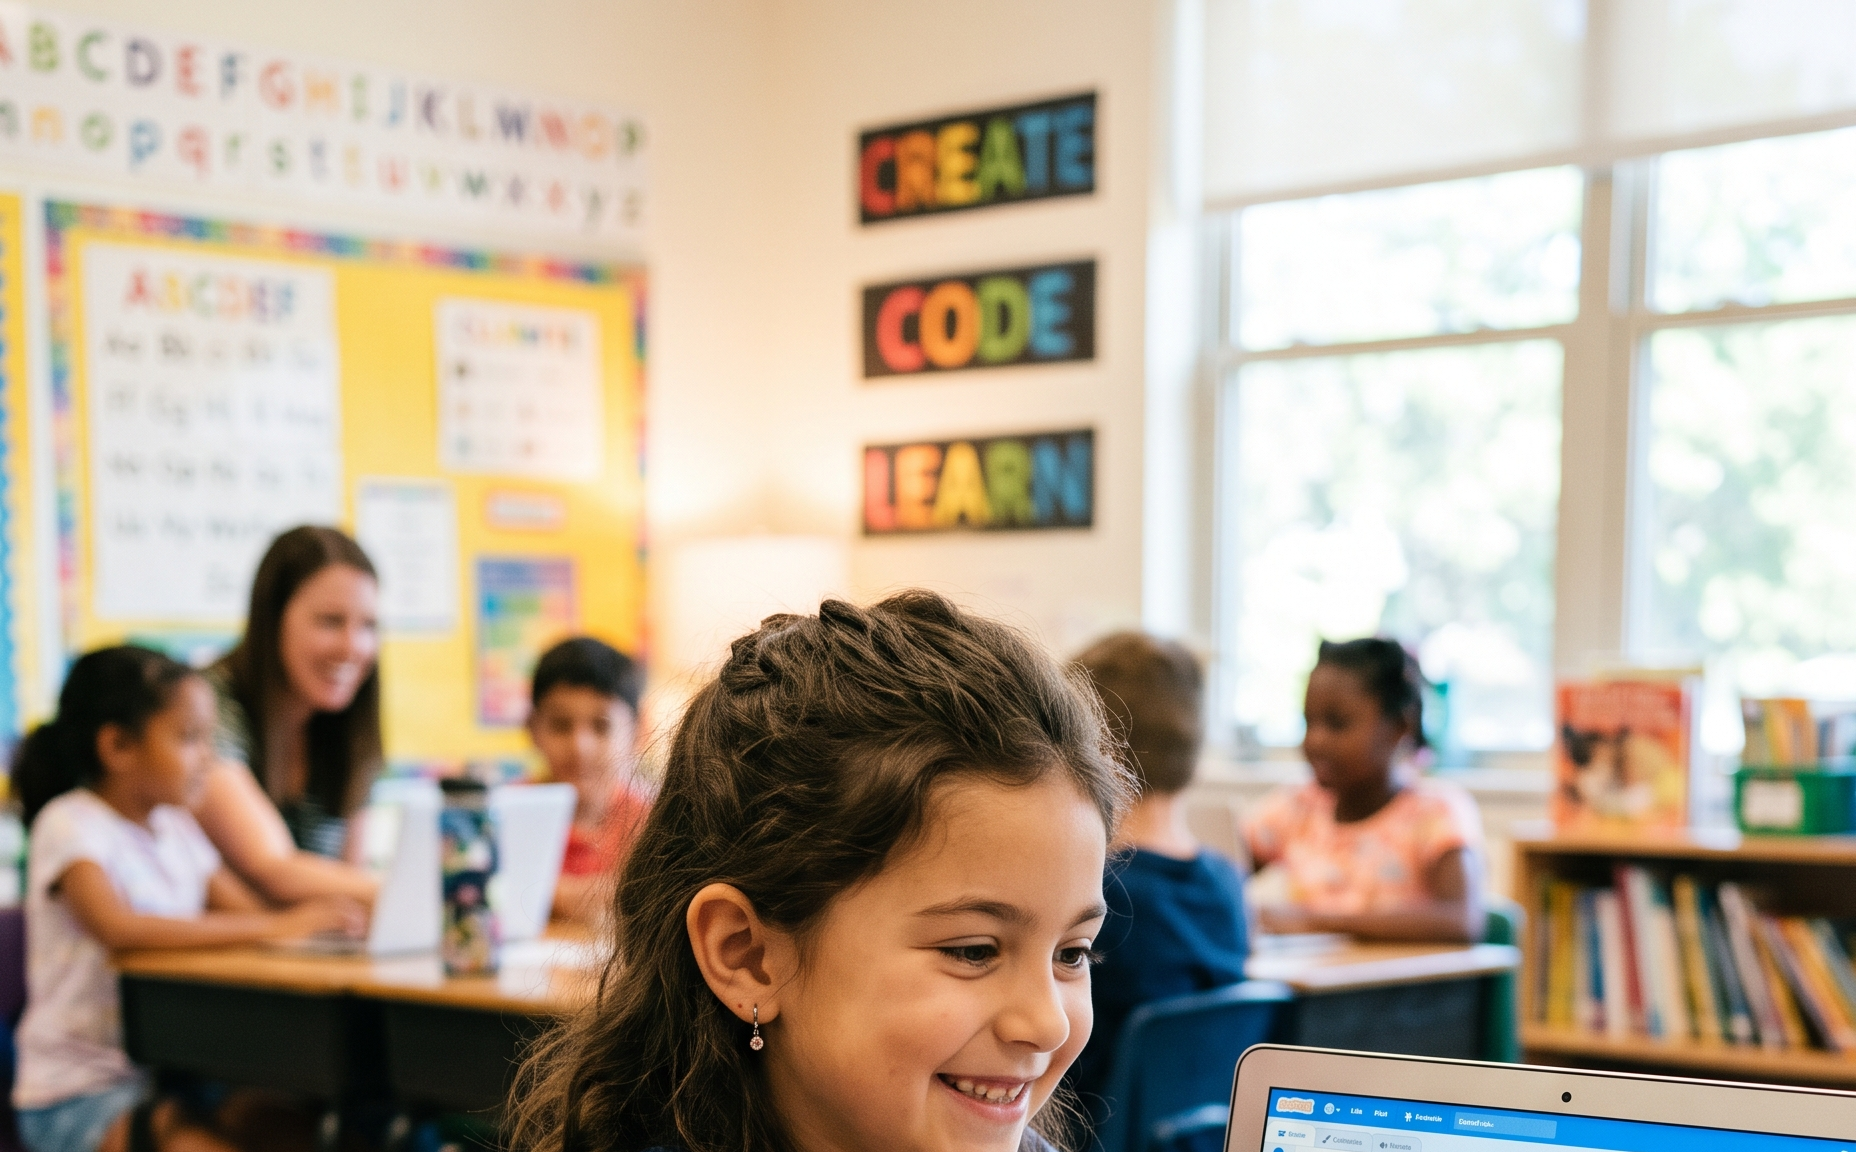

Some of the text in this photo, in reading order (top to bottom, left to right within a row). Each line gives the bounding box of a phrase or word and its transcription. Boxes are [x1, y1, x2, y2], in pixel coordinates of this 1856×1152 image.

[861, 104, 1092, 214] CREATE
[877, 271, 1074, 372] CODE
[865, 439, 1090, 531] LEARN
